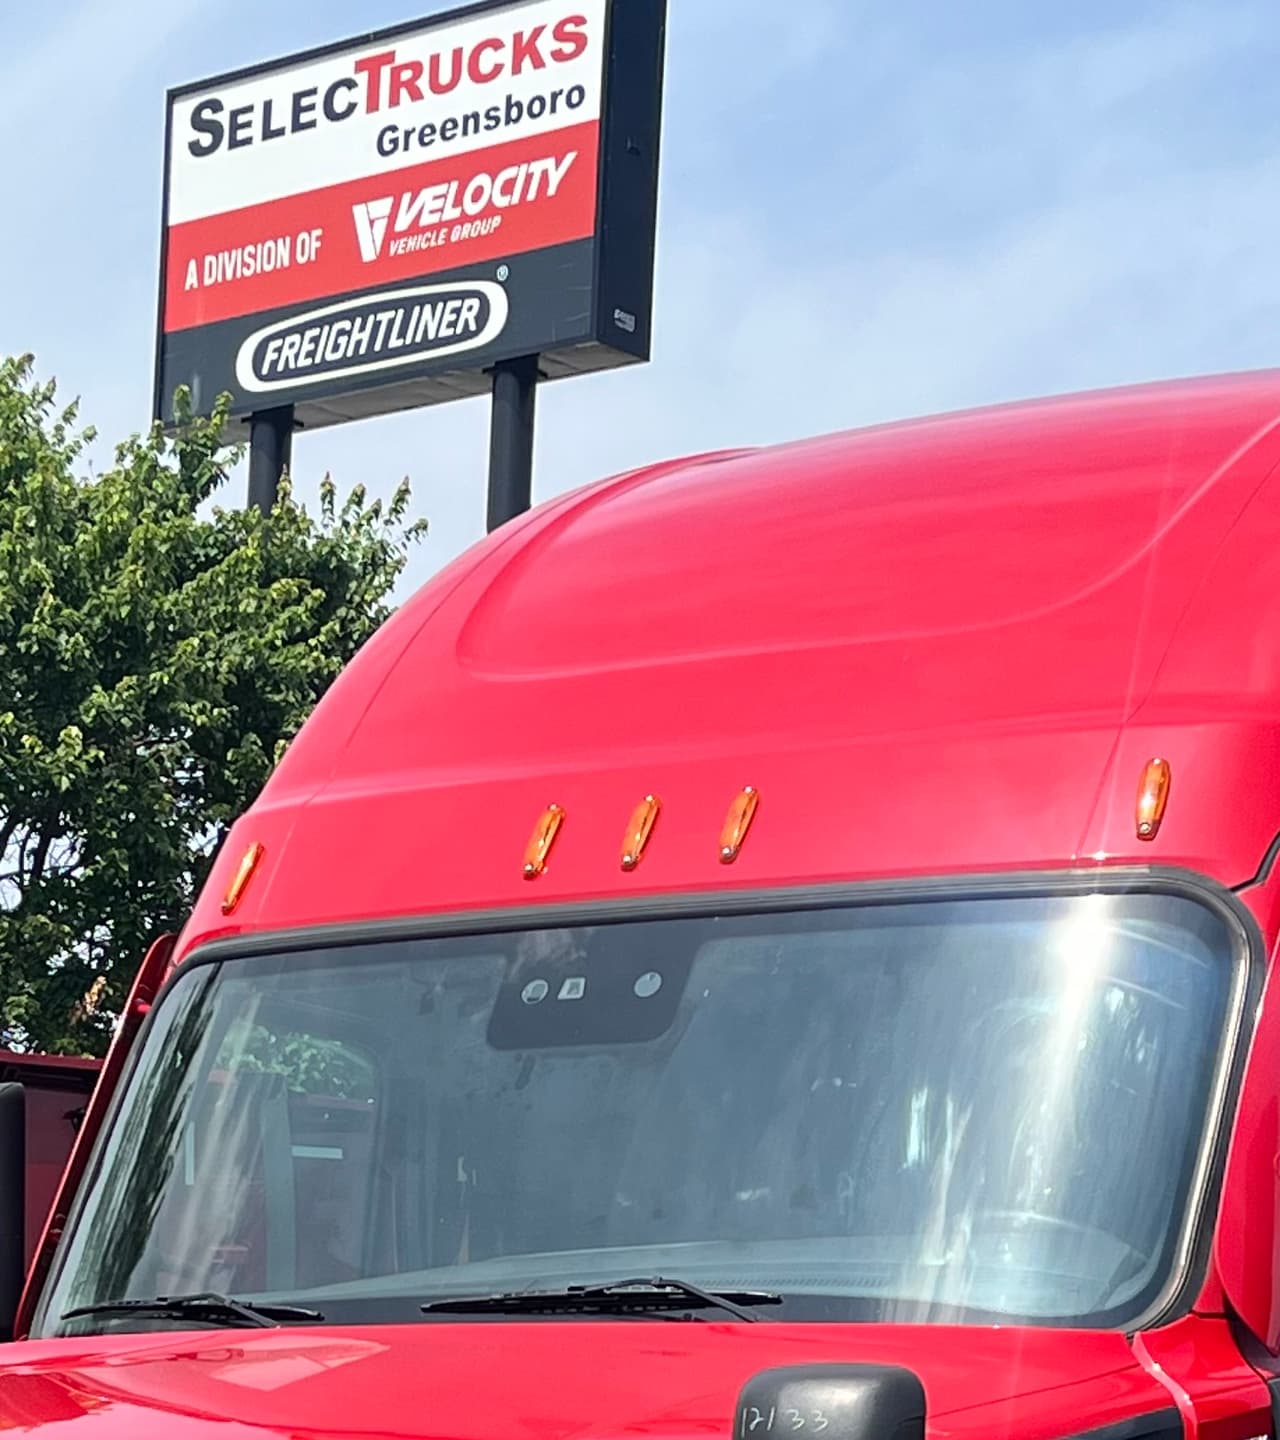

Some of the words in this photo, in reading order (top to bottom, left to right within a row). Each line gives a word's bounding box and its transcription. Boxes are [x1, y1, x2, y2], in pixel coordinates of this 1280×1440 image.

[376, 83, 586, 158] Greensboro
[394, 150, 578, 233] VELOCITY
[184, 258, 199, 291] A
[203, 236, 291, 287] DIVISION
[295, 228, 323, 264] OF
[389, 228, 448, 257] VEHICLE
[450, 215, 502, 242] GROUP
[260, 297, 482, 377] FREIGHTLINER
